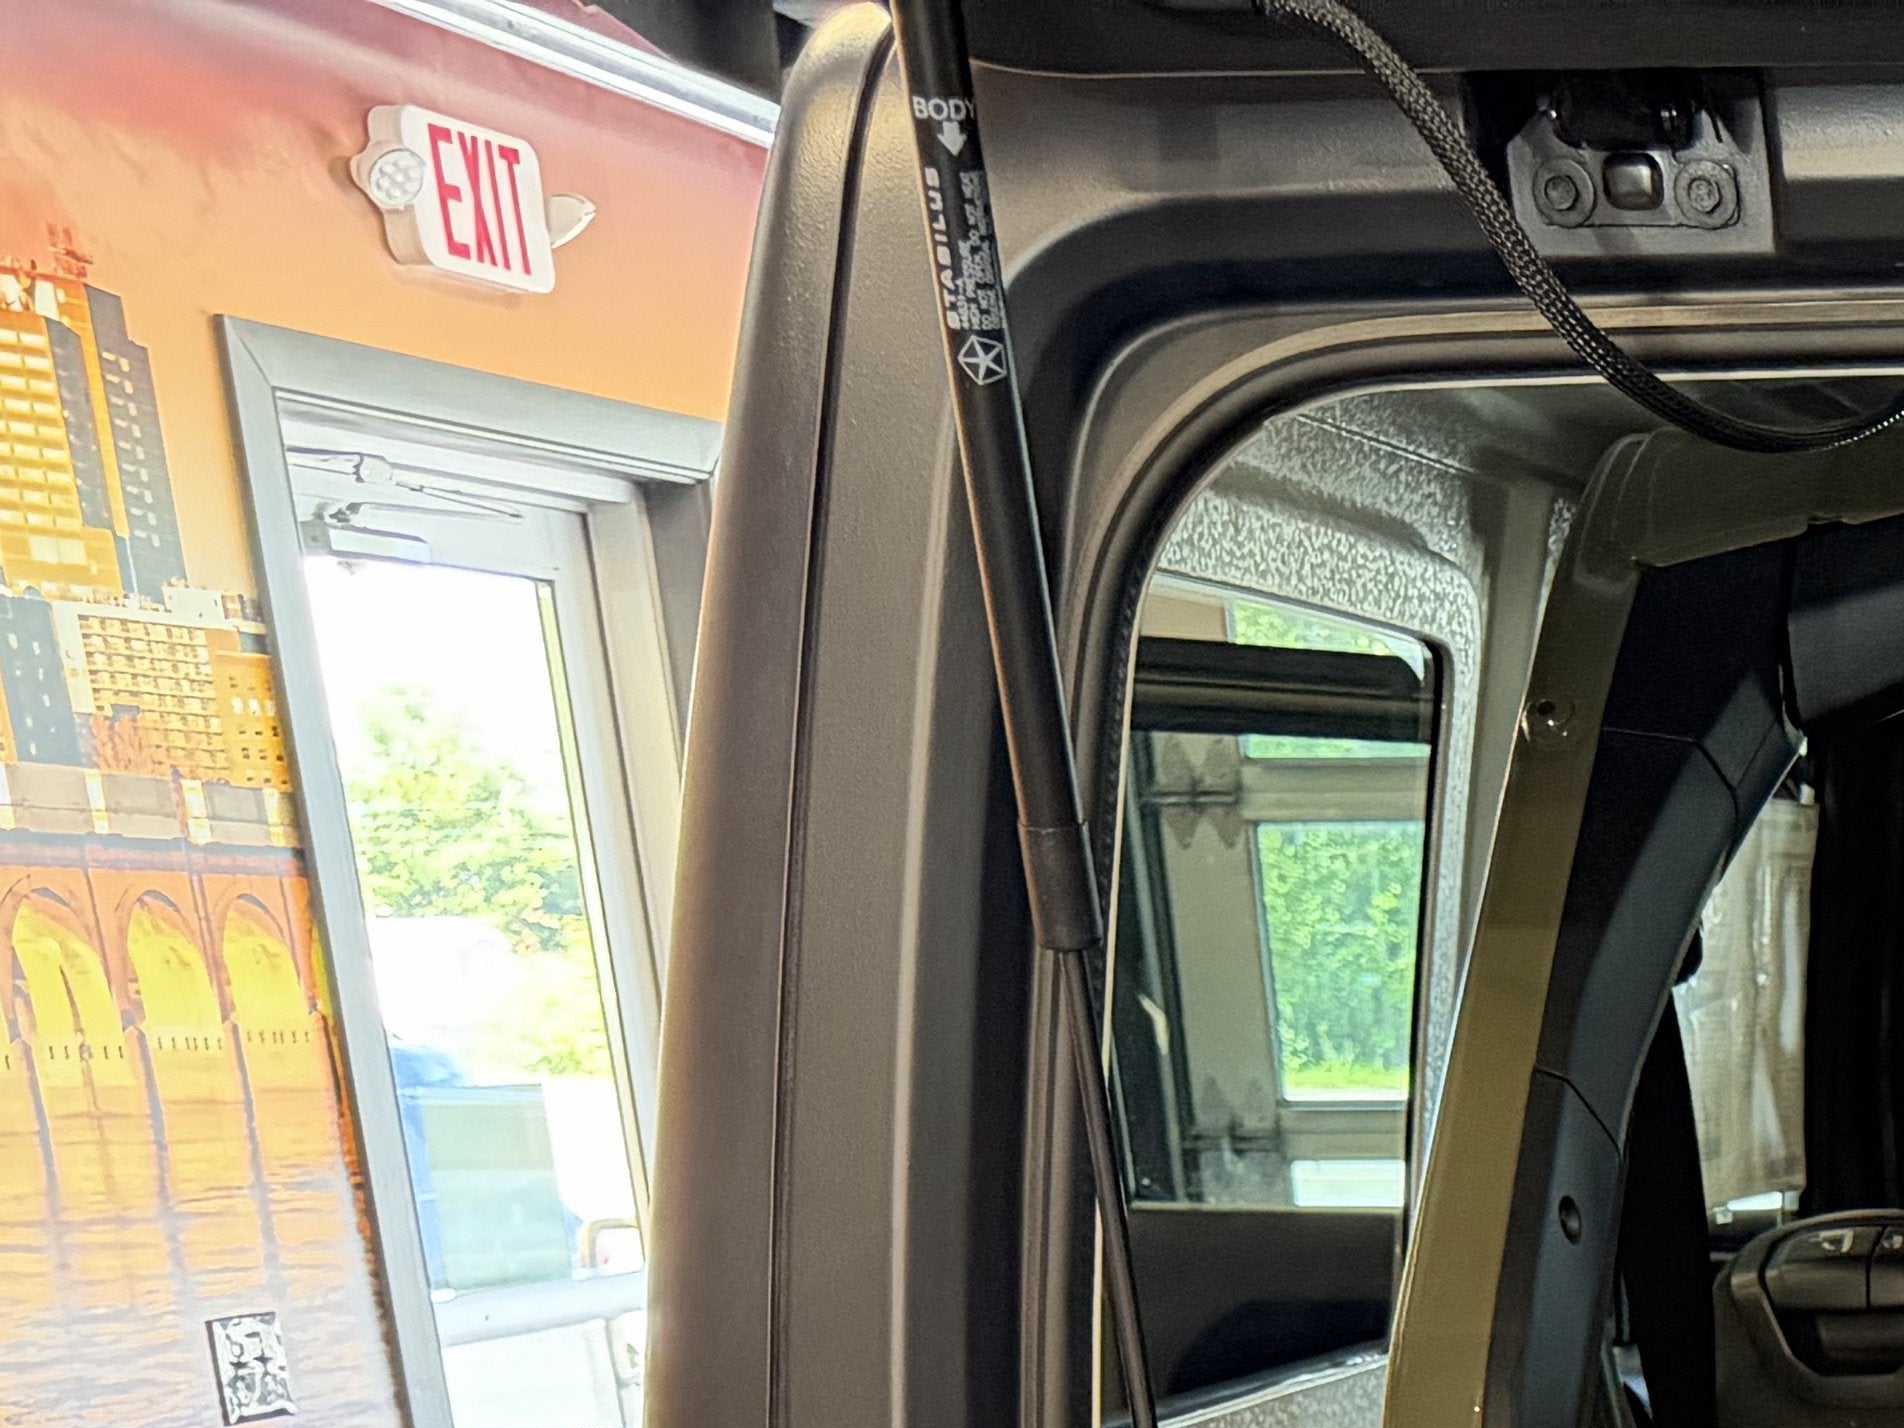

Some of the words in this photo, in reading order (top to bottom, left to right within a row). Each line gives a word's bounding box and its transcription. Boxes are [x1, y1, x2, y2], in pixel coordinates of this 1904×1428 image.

[912, 96, 976, 120] BODY
[427, 123, 532, 276] EXIT
[924, 166, 961, 330] STABILUS
